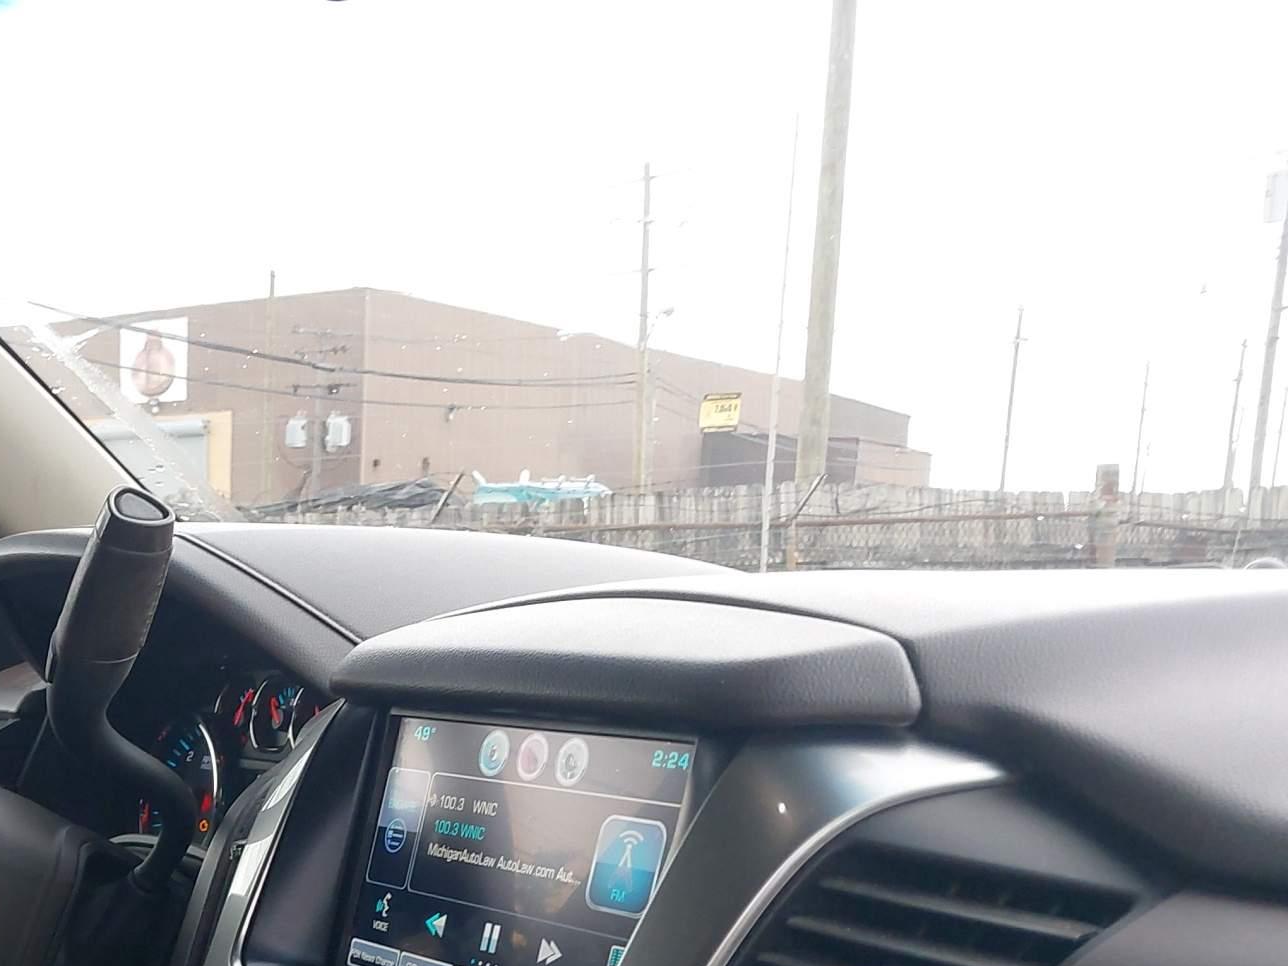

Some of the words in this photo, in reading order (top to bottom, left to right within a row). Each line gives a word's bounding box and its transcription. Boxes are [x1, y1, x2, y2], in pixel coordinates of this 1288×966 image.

[651, 750, 691, 771] 2:24
[439, 794, 466, 812] 100.3
[472, 799, 499, 817] WNIC
[434, 819, 460, 836] 100.3
[460, 825, 487, 841] WNIC
